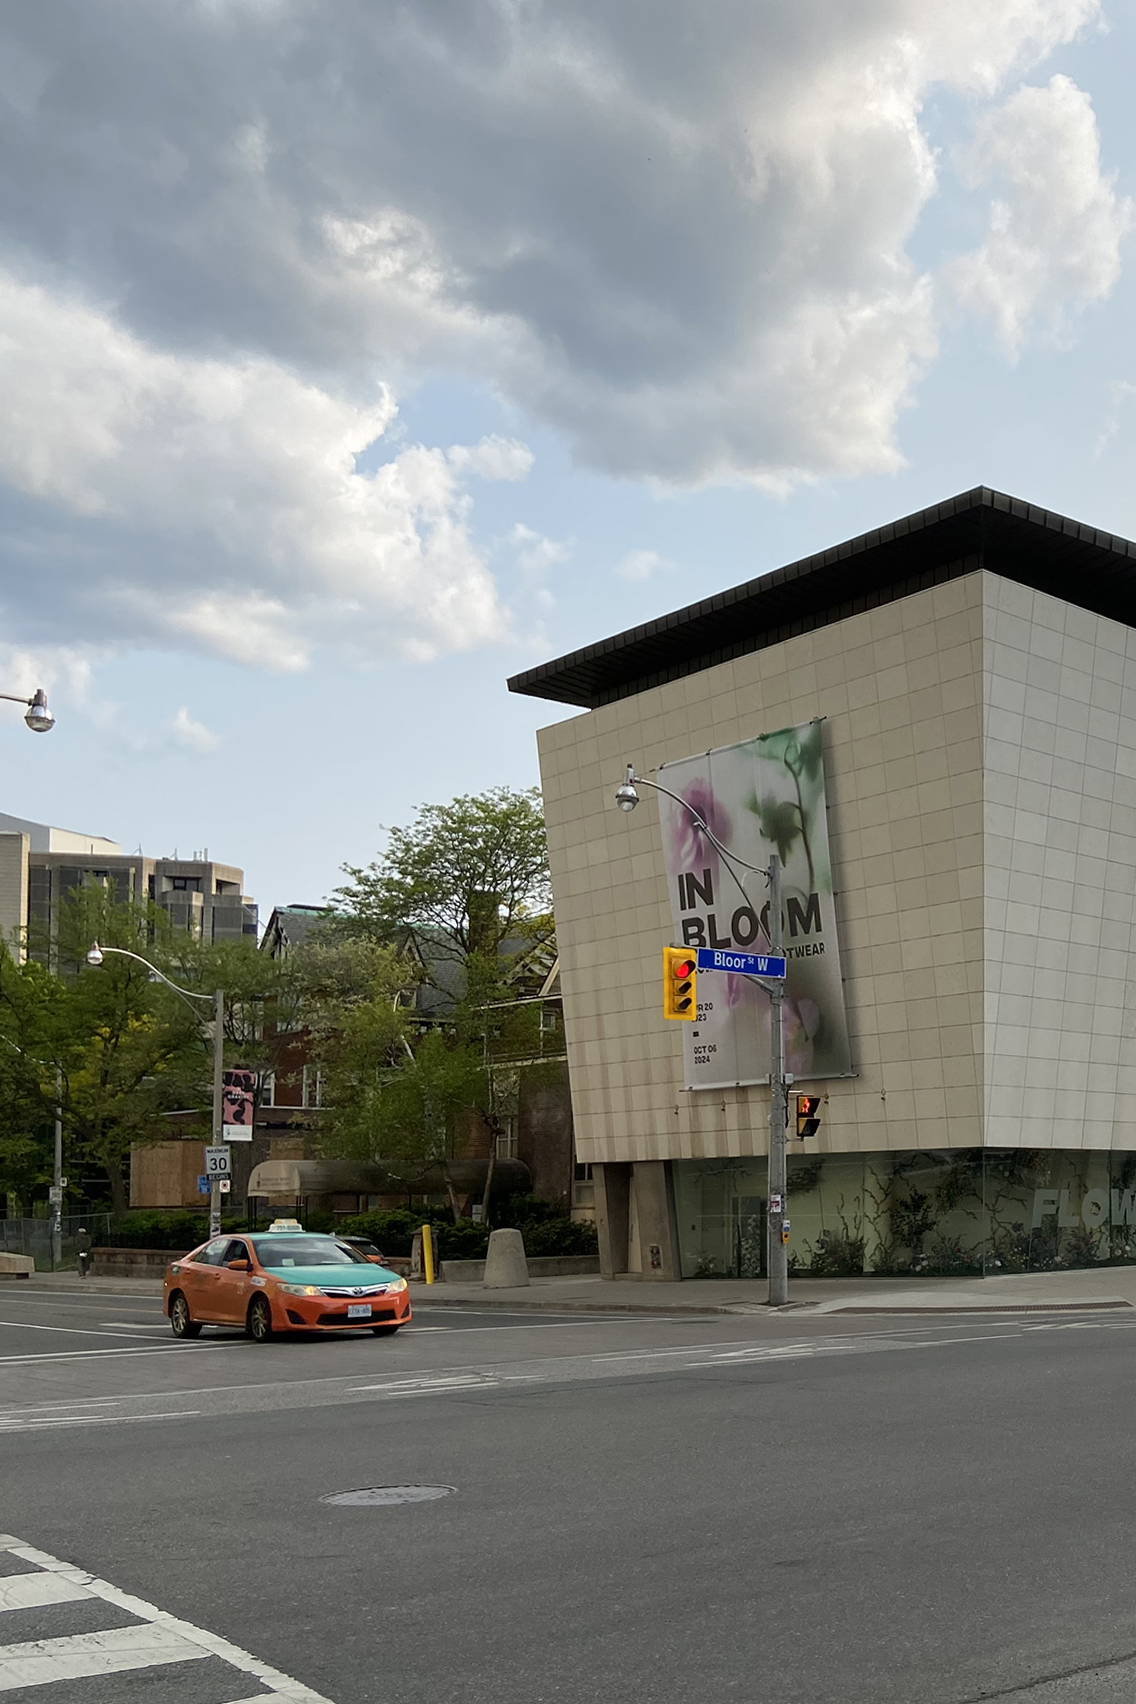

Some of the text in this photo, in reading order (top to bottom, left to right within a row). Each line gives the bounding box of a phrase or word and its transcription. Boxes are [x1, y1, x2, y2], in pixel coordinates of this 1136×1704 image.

[678, 868, 714, 911] IN
[714, 951, 746, 969] Bloor
[747, 956, 755, 965] St
[757, 958, 769, 971] W
[694, 1046, 706, 1054] OCT
[694, 1055, 710, 1064] 2024
[210, 1158, 227, 1170] 30
[208, 1173, 229, 1181] BEGINS
